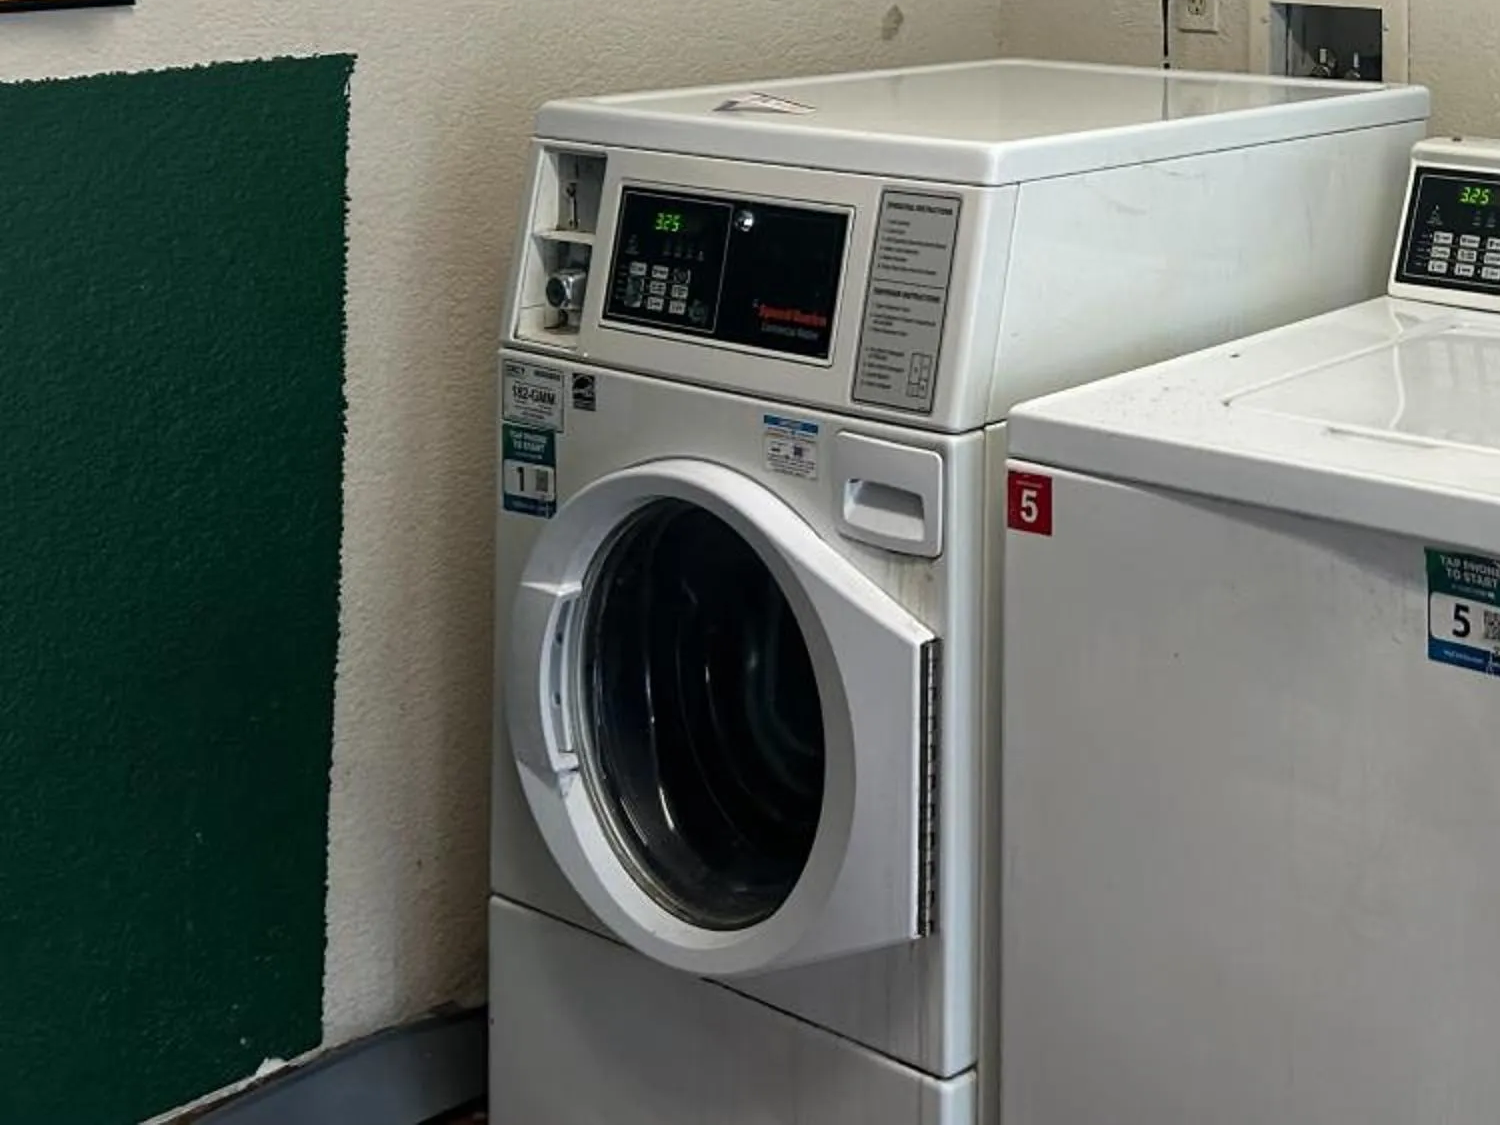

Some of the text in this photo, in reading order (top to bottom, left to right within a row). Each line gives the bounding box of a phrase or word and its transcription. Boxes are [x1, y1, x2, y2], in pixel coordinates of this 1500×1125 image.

[1021, 488, 1039, 523] 5
[1464, 572, 1499, 589] START
[1452, 603, 1471, 638] 5
